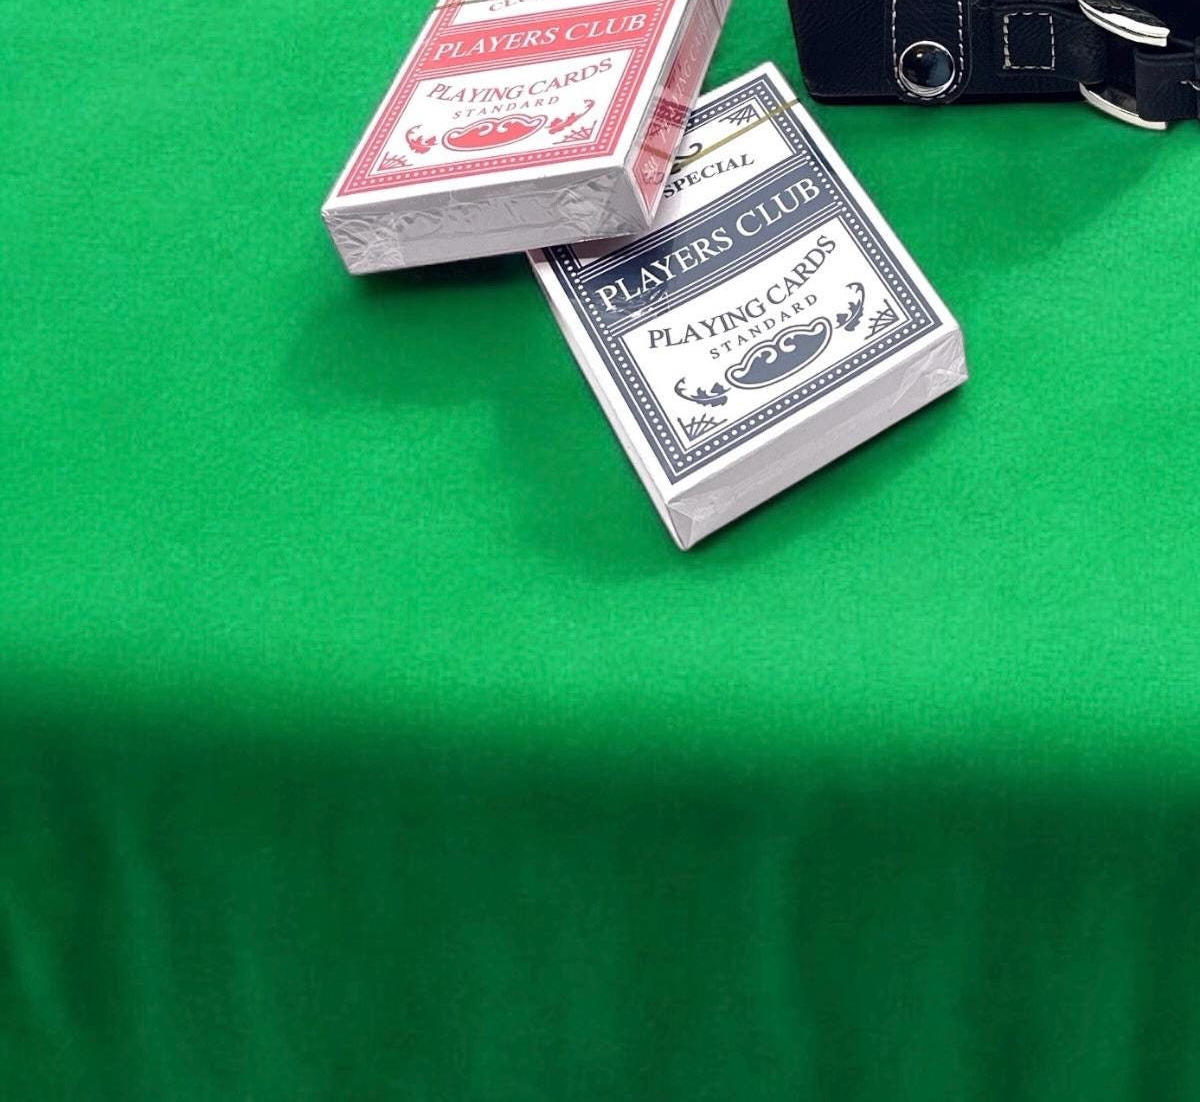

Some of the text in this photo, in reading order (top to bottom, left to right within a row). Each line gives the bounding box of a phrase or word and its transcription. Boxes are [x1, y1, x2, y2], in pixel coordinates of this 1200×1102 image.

[433, 13, 647, 61] PLAYERS CLUB
[427, 57, 612, 103] PLAYING CARDS
[452, 96, 560, 119] STANDARD
[663, 153, 754, 199] SPECIAL
[595, 177, 820, 312] PLAYERS CLUB
[647, 234, 836, 349] PLAYING CARDS
[709, 293, 818, 359] STANDARD
